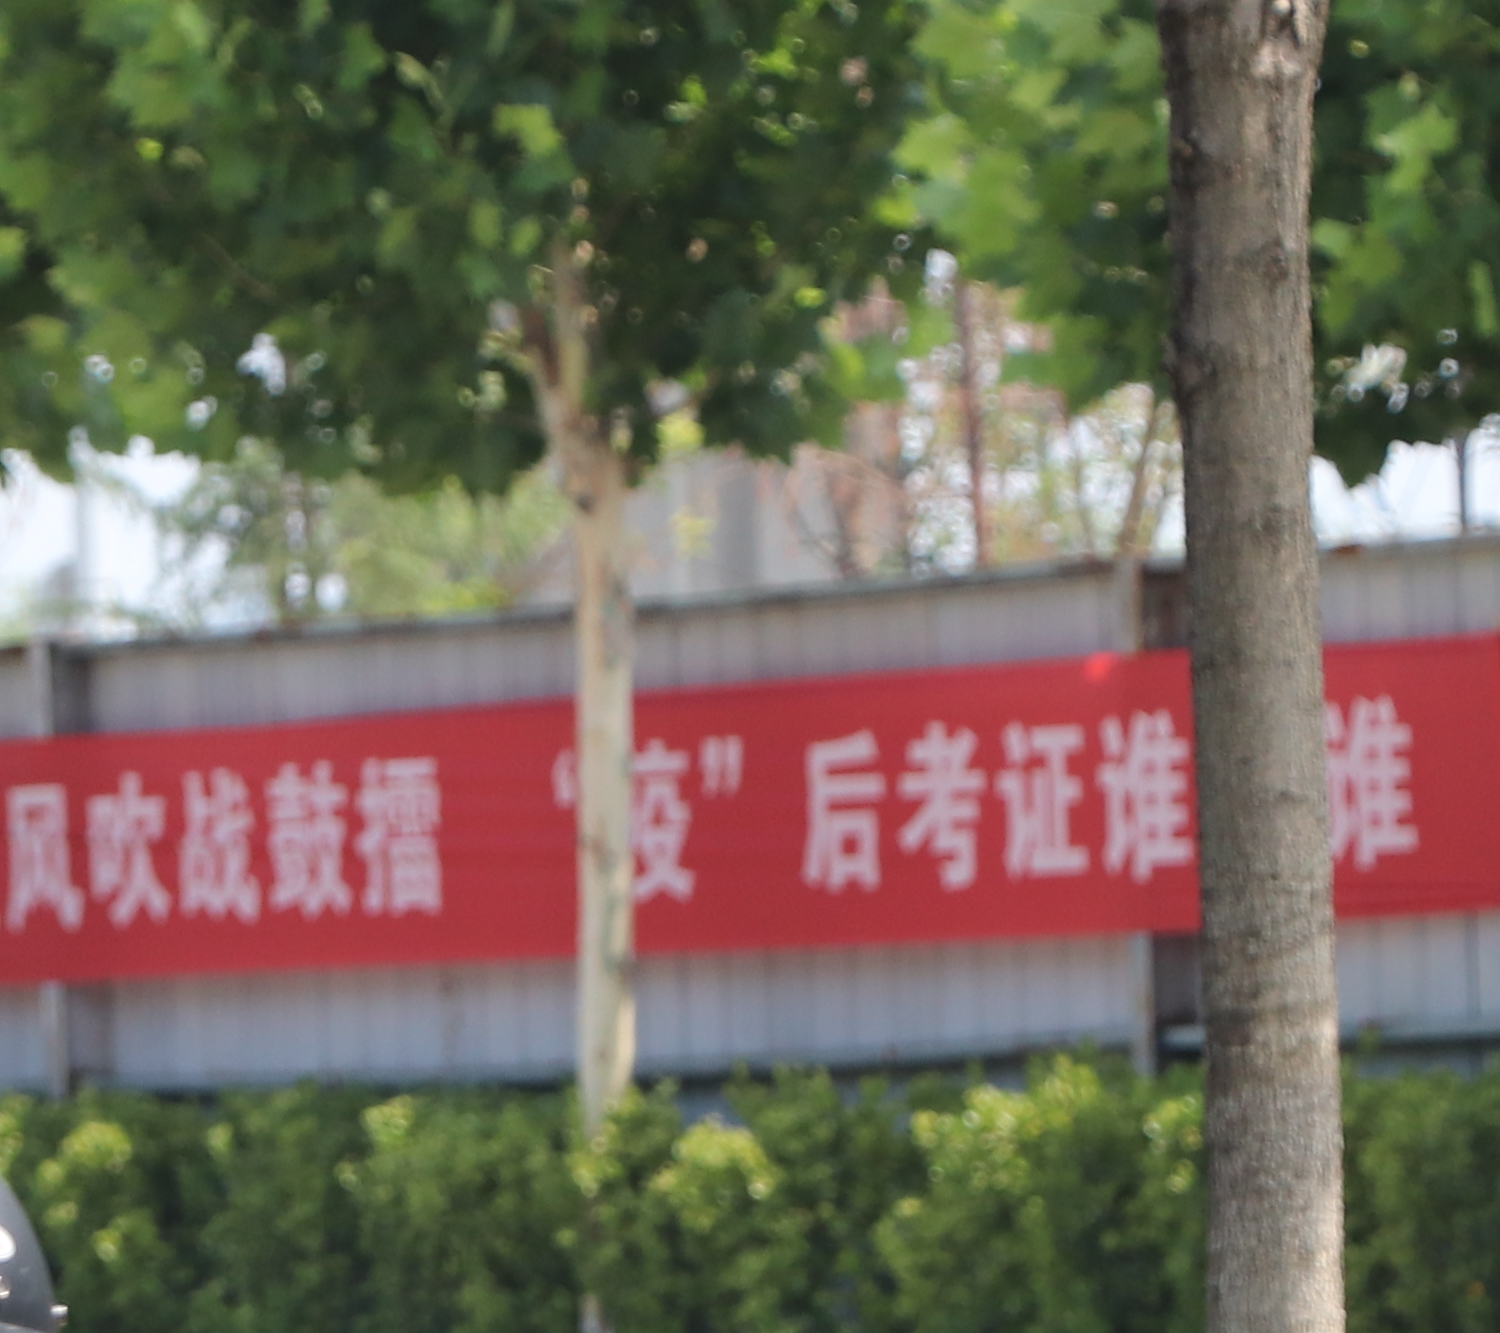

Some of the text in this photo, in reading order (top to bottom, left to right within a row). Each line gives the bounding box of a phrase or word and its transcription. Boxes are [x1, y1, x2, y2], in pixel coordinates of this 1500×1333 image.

[551, 694, 1422, 904] “疫”后考证谁谁
